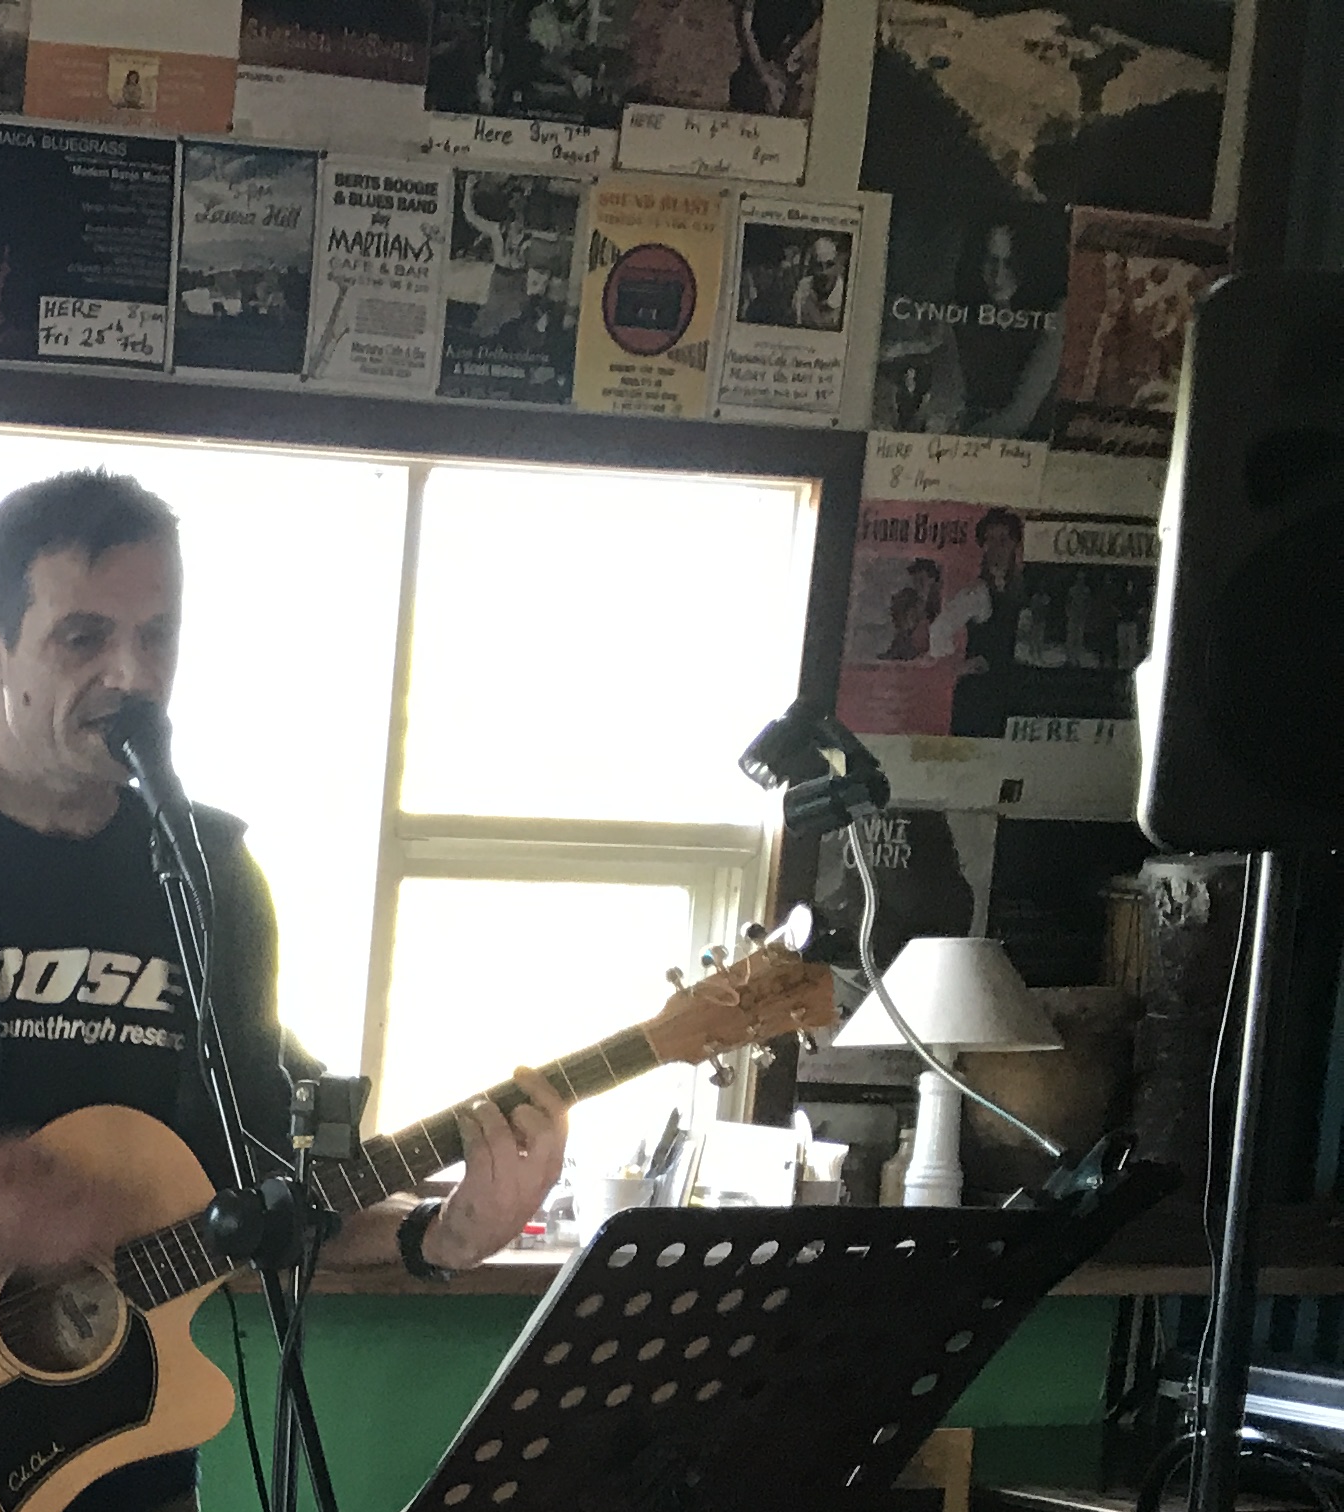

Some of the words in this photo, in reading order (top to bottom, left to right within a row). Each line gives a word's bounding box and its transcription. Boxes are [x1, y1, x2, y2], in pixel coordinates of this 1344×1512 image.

[475, 117, 515, 145] Here
[41, 135, 128, 157] BLUEGRASS
[45, 300, 102, 319] HERE
[892, 296, 969, 325] CYNDI
[979, 304, 1059, 331] BOSTE
[1011, 719, 1080, 743] HERE
